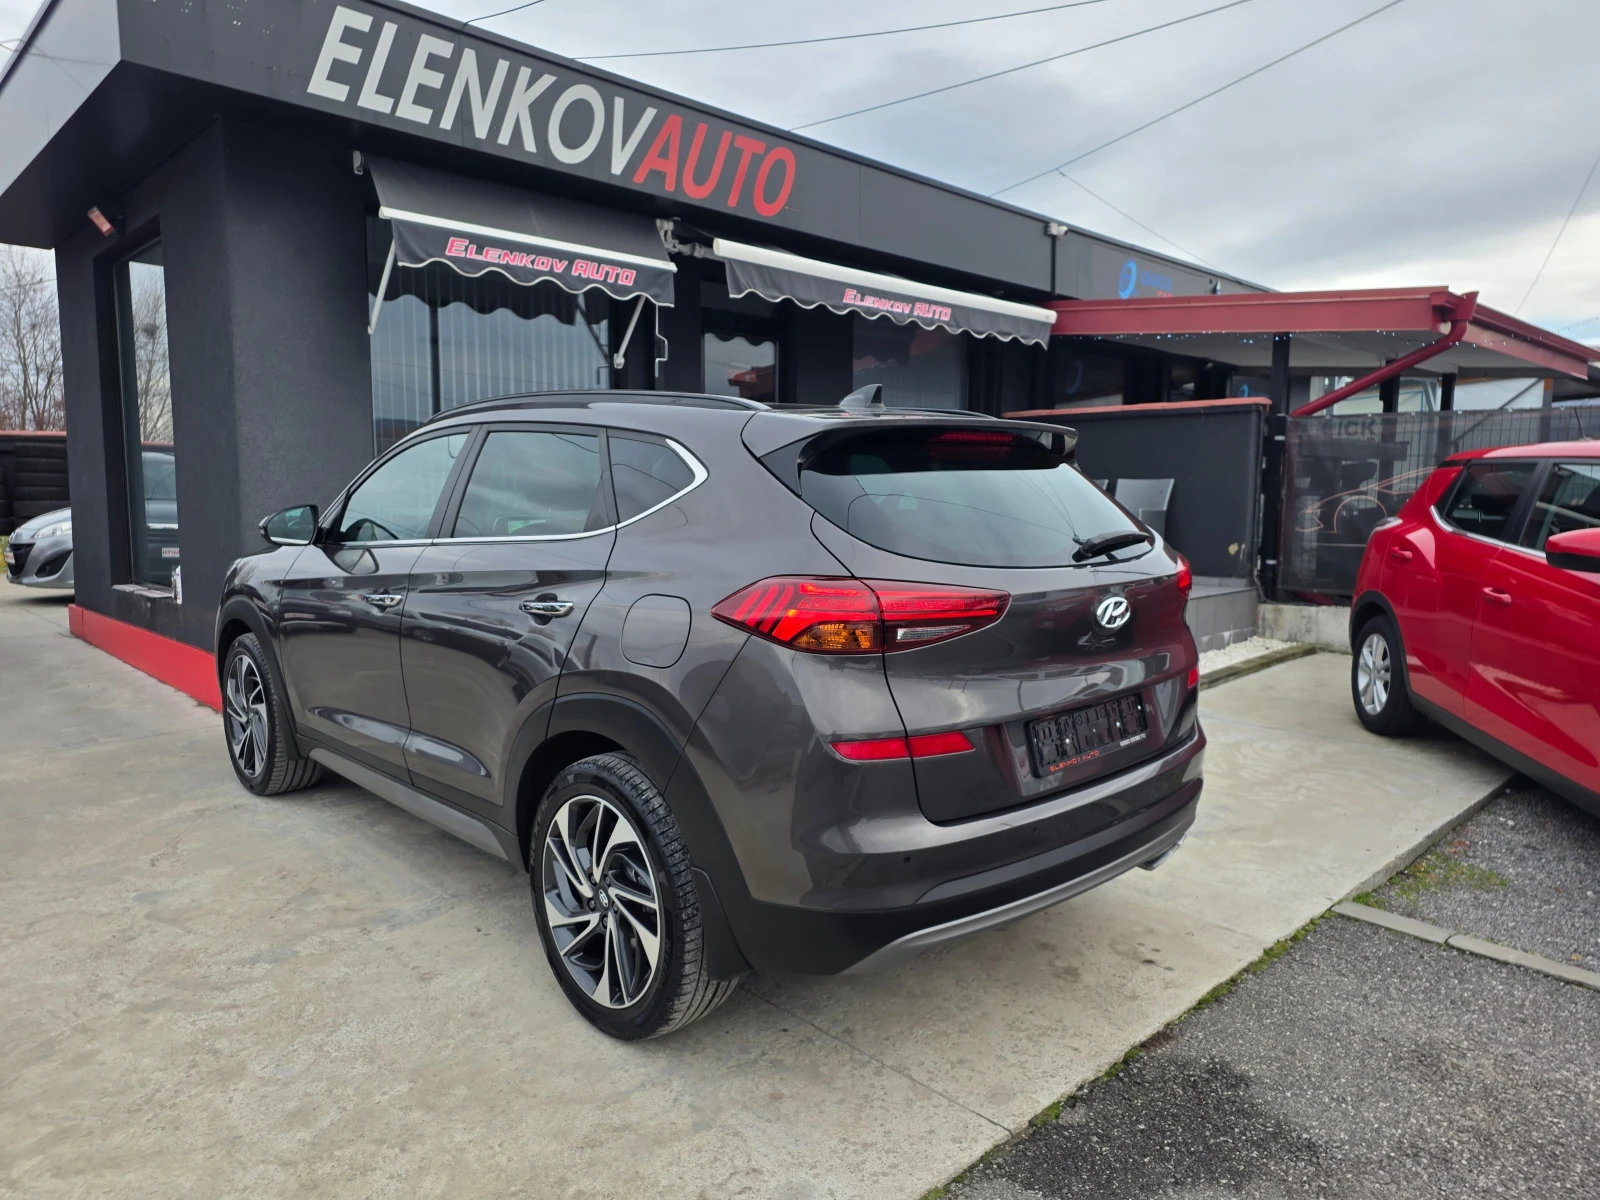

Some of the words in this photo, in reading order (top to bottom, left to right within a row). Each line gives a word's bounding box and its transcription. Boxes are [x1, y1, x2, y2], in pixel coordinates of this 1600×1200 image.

[445, 236, 568, 274] ELENKOV
[571, 258, 636, 287] AUTO
[842, 287, 912, 314] ELENKOV
[913, 301, 952, 321] AUTO
[1082, 750, 1100, 761] AUTO
